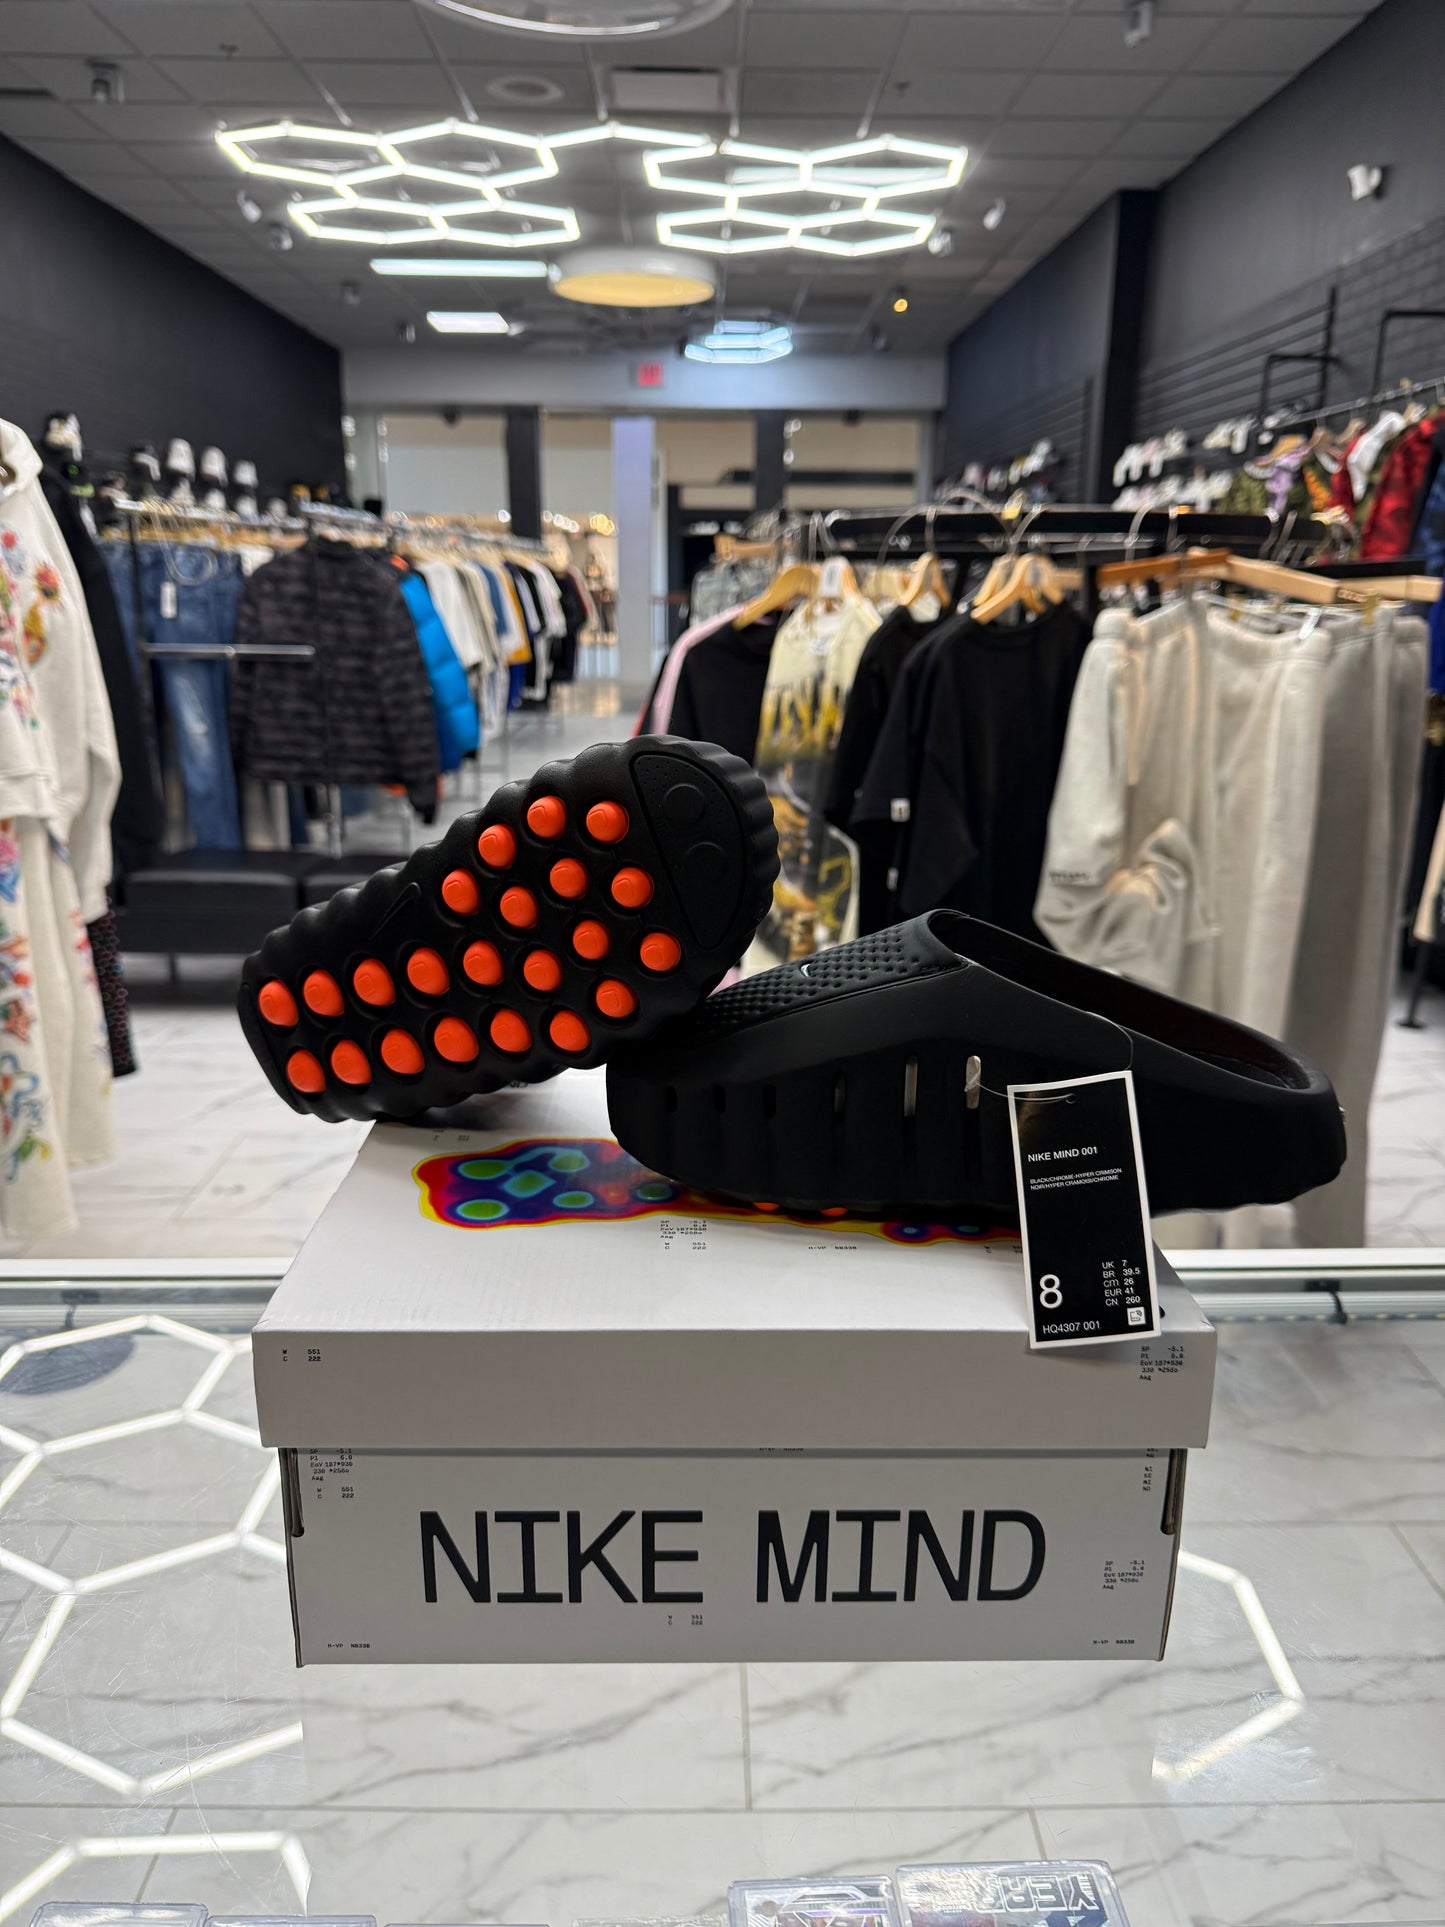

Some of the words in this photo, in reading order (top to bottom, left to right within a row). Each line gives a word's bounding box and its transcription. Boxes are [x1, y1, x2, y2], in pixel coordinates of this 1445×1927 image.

[1028, 1152, 1051, 1162] NIKE
[1053, 1148, 1079, 1159] MIND
[1082, 1147, 1098, 1155] 001
[1123, 1268, 1140, 1276] 39.5
[1040, 1274, 1062, 1308] 8
[1105, 1288, 1122, 1297] EUR
[1106, 1298, 1118, 1306] CN
[1126, 1296, 1140, 1304] 260
[1043, 1322, 1080, 1334] HQ4307
[1083, 1321, 1100, 1330] 001
[420, 1510, 703, 1603] NIKE
[756, 1510, 1046, 1602] MIND
